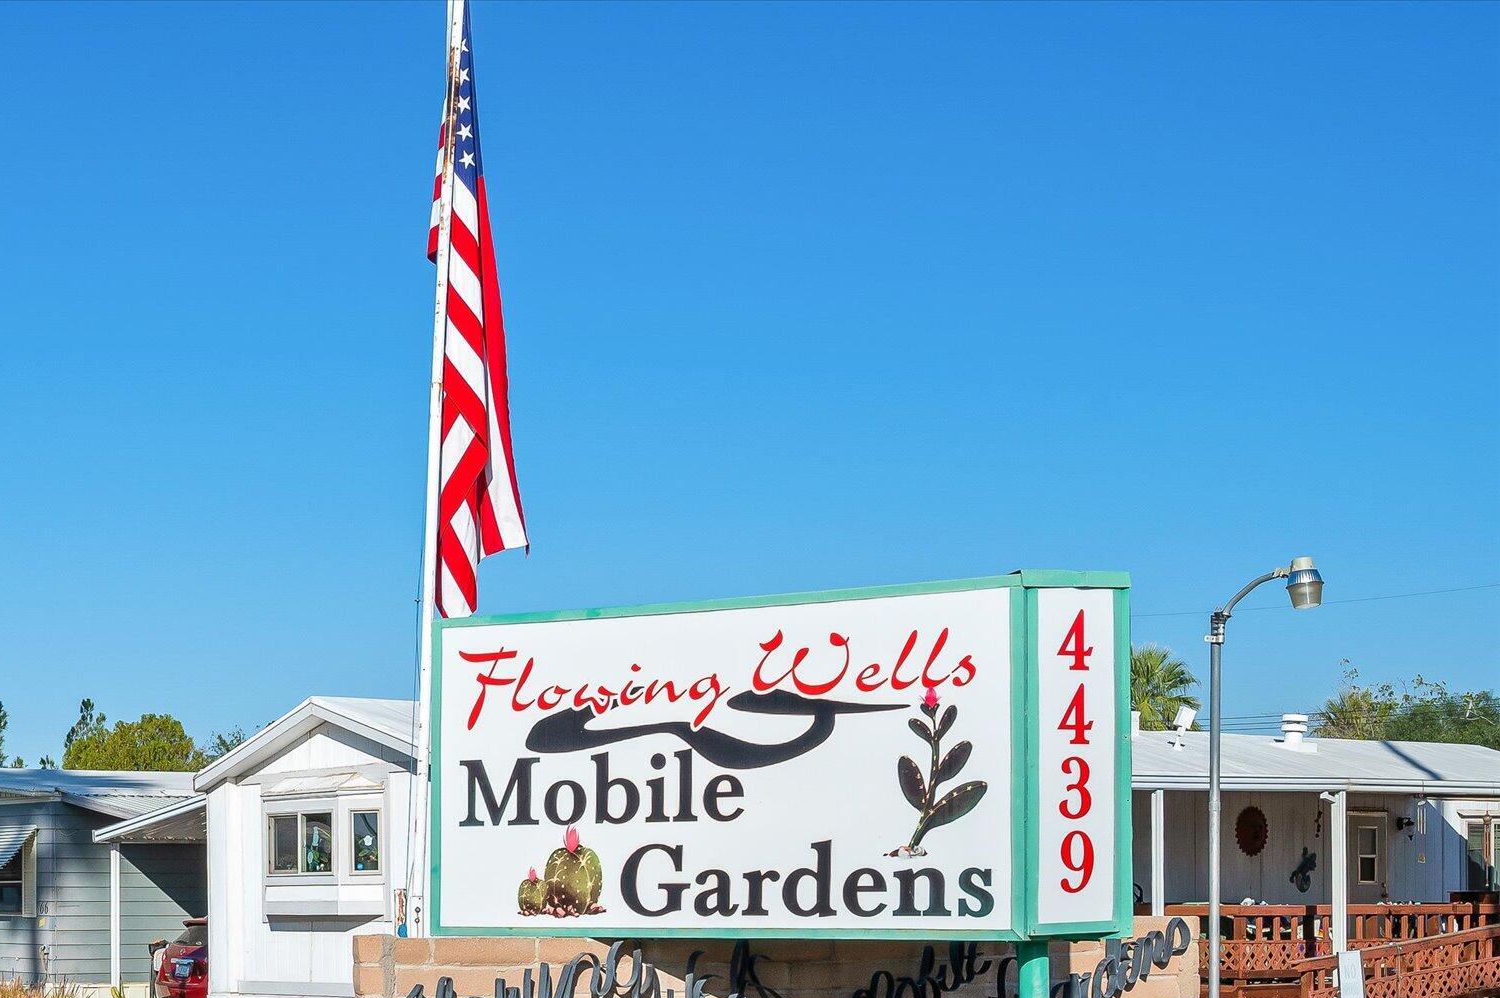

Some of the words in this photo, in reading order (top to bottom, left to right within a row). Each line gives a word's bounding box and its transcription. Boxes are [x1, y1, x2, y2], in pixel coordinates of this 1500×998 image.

[458, 646, 731, 730] Flowing
[751, 627, 978, 696] Wells
[458, 748, 745, 828] Mobile
[619, 839, 994, 919] Gardens
